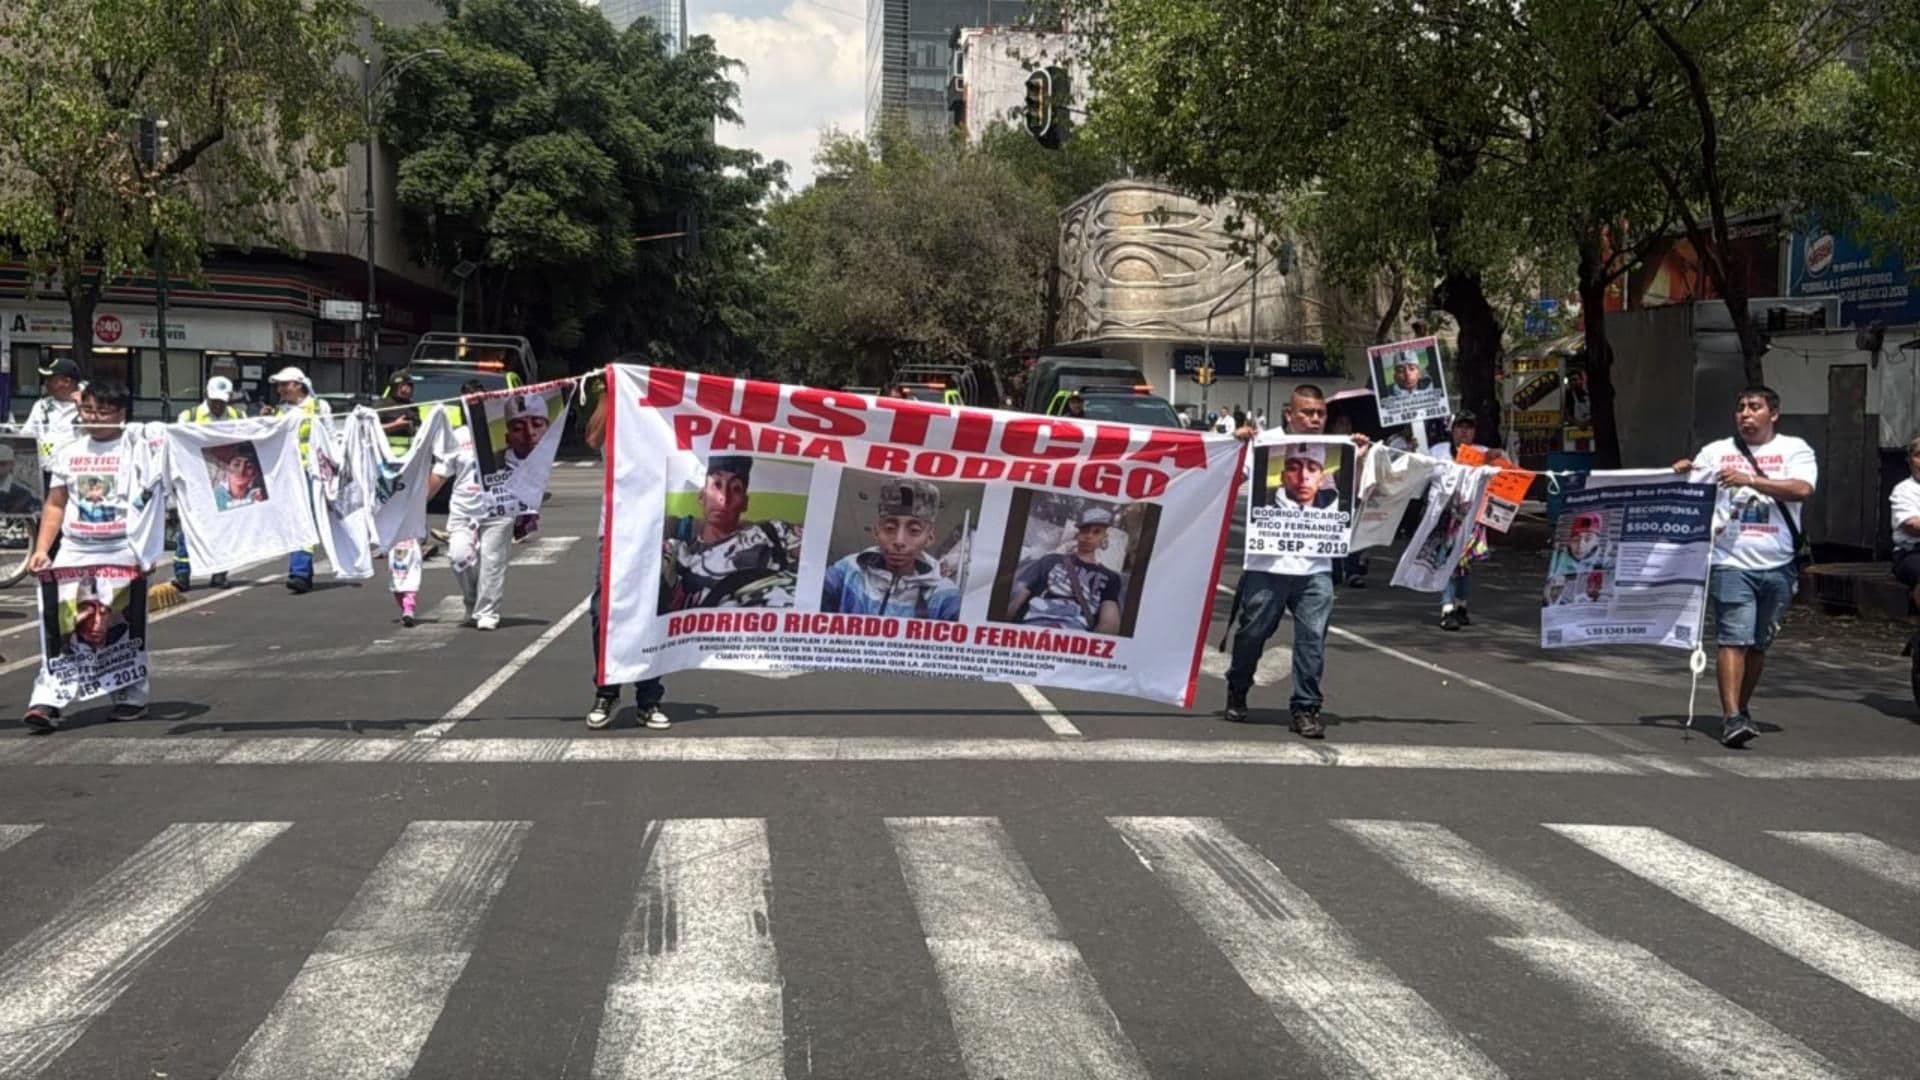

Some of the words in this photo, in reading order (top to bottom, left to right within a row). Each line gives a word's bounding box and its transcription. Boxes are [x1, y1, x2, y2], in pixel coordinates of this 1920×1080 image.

[1290, 359, 1320, 372] BBVA
[639, 366, 1208, 471] JUSTICIA
[1401, 411, 1418, 420] SEP
[69, 456, 121, 465] JUSTICI
[673, 414, 848, 464] PARA
[865, 444, 1170, 500] RODRIGO
[1253, 508, 1300, 519] RODRIGO
[1303, 509, 1349, 521] RICARDO
[1628, 504, 1700, 516] RECOMPENSA
[1256, 521, 1282, 529] RICO
[1248, 538, 1265, 551] 28
[1277, 539, 1305, 552] SEP
[1316, 541, 1348, 554] 2019
[667, 612, 778, 638] RODRIGO
[783, 613, 899, 638] RICARDO
[905, 619, 968, 644] RICO
[973, 626, 1116, 659] FERNÁNDEZ
[677, 636, 725, 645] SEPTIEMBRE
[779, 636, 820, 644] CUMPLEN
[828, 637, 852, 646] AÑOS
[854, 639, 866, 647] EN
[867, 640, 885, 648] QUE
[887, 641, 953, 653] DESAPARECISTE
[966, 647, 995, 656] FUISTE
[1036, 653, 1087, 666] SEPTIEMBRE
[1089, 660, 1104, 668] DEL
[781, 645, 800, 653] QUE
[813, 647, 861, 655] TENGAMOS
[863, 649, 906, 658] SOLUCIÓN
[932, 653, 976, 663] CARPETAS
[990, 658, 1056, 671] INVESTIGACIÓN
[757, 653, 782, 661] AÑOS
[784, 653, 813, 662] TIENEN
[815, 655, 833, 663] QUE
[834, 656, 862, 664] PASAR
[864, 657, 886, 666] PARA
[888, 658, 906, 667] QUE
[921, 662, 958, 670] JUSTICIA
[960, 665, 984, 673] HAGA
[999, 666, 1037, 677] TRABAJO
